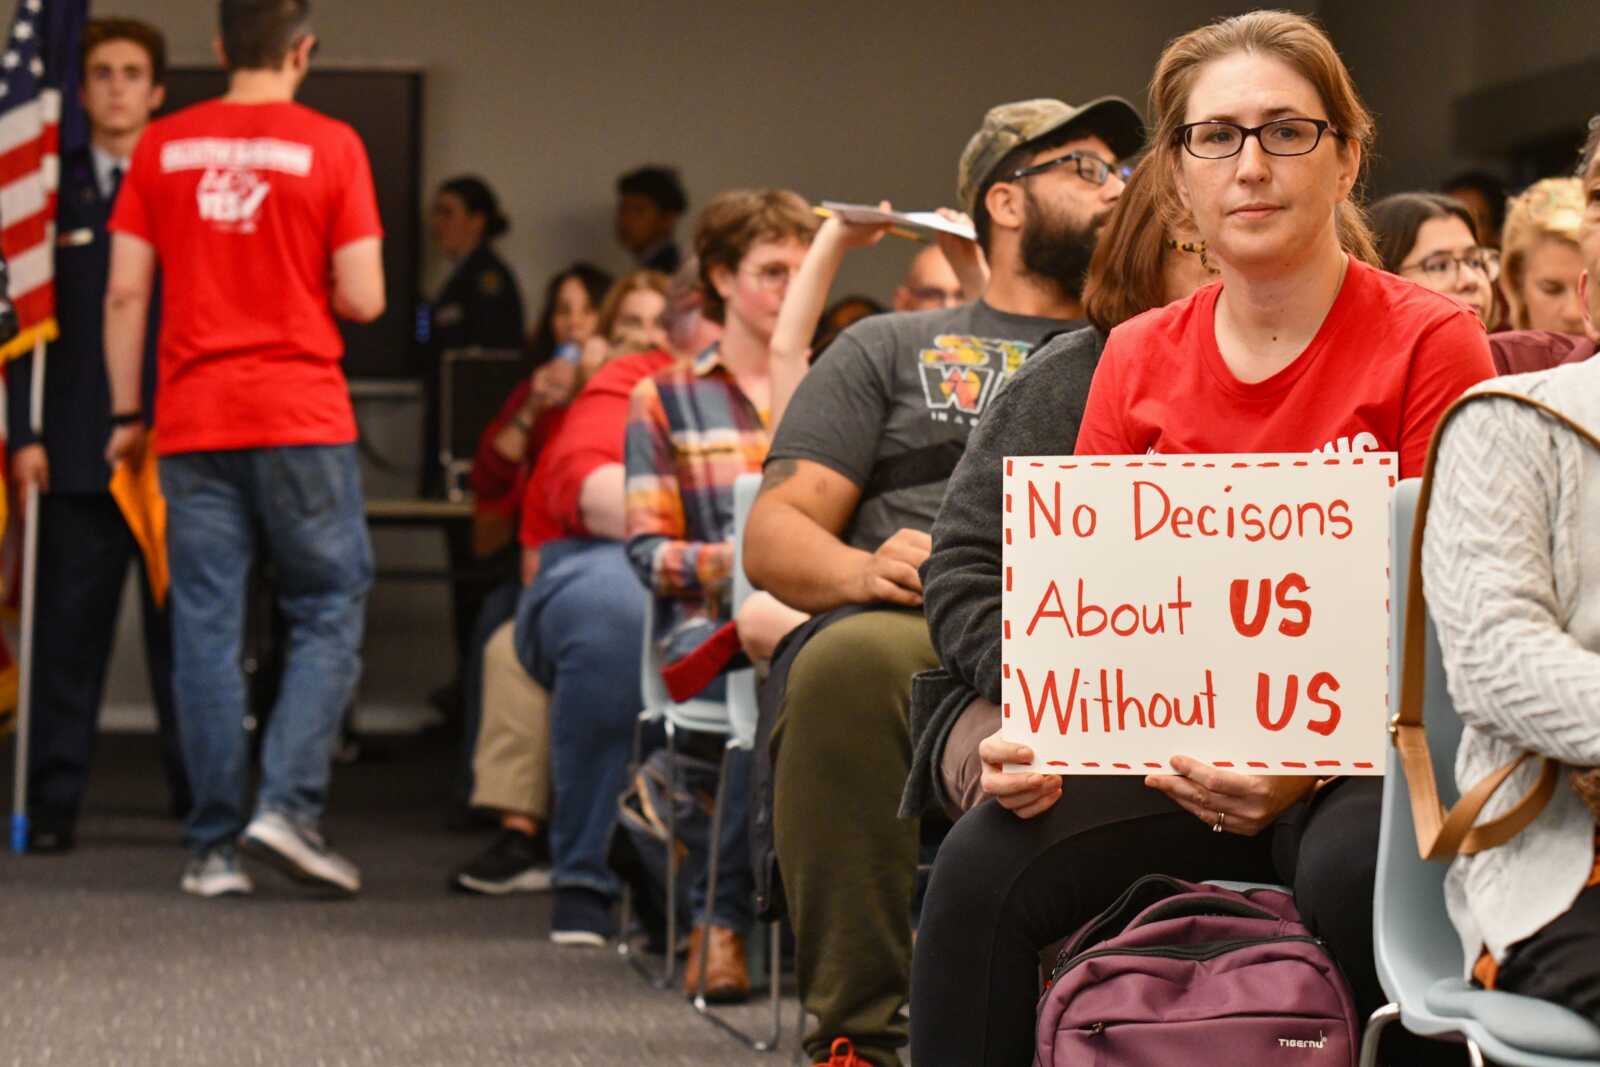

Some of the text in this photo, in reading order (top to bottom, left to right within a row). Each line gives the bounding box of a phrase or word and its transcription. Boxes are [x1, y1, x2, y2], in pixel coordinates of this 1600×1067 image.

[1027, 480, 1353, 542] No Decisons
[1026, 572, 1312, 638] About US
[1016, 668, 1342, 736] Without US
